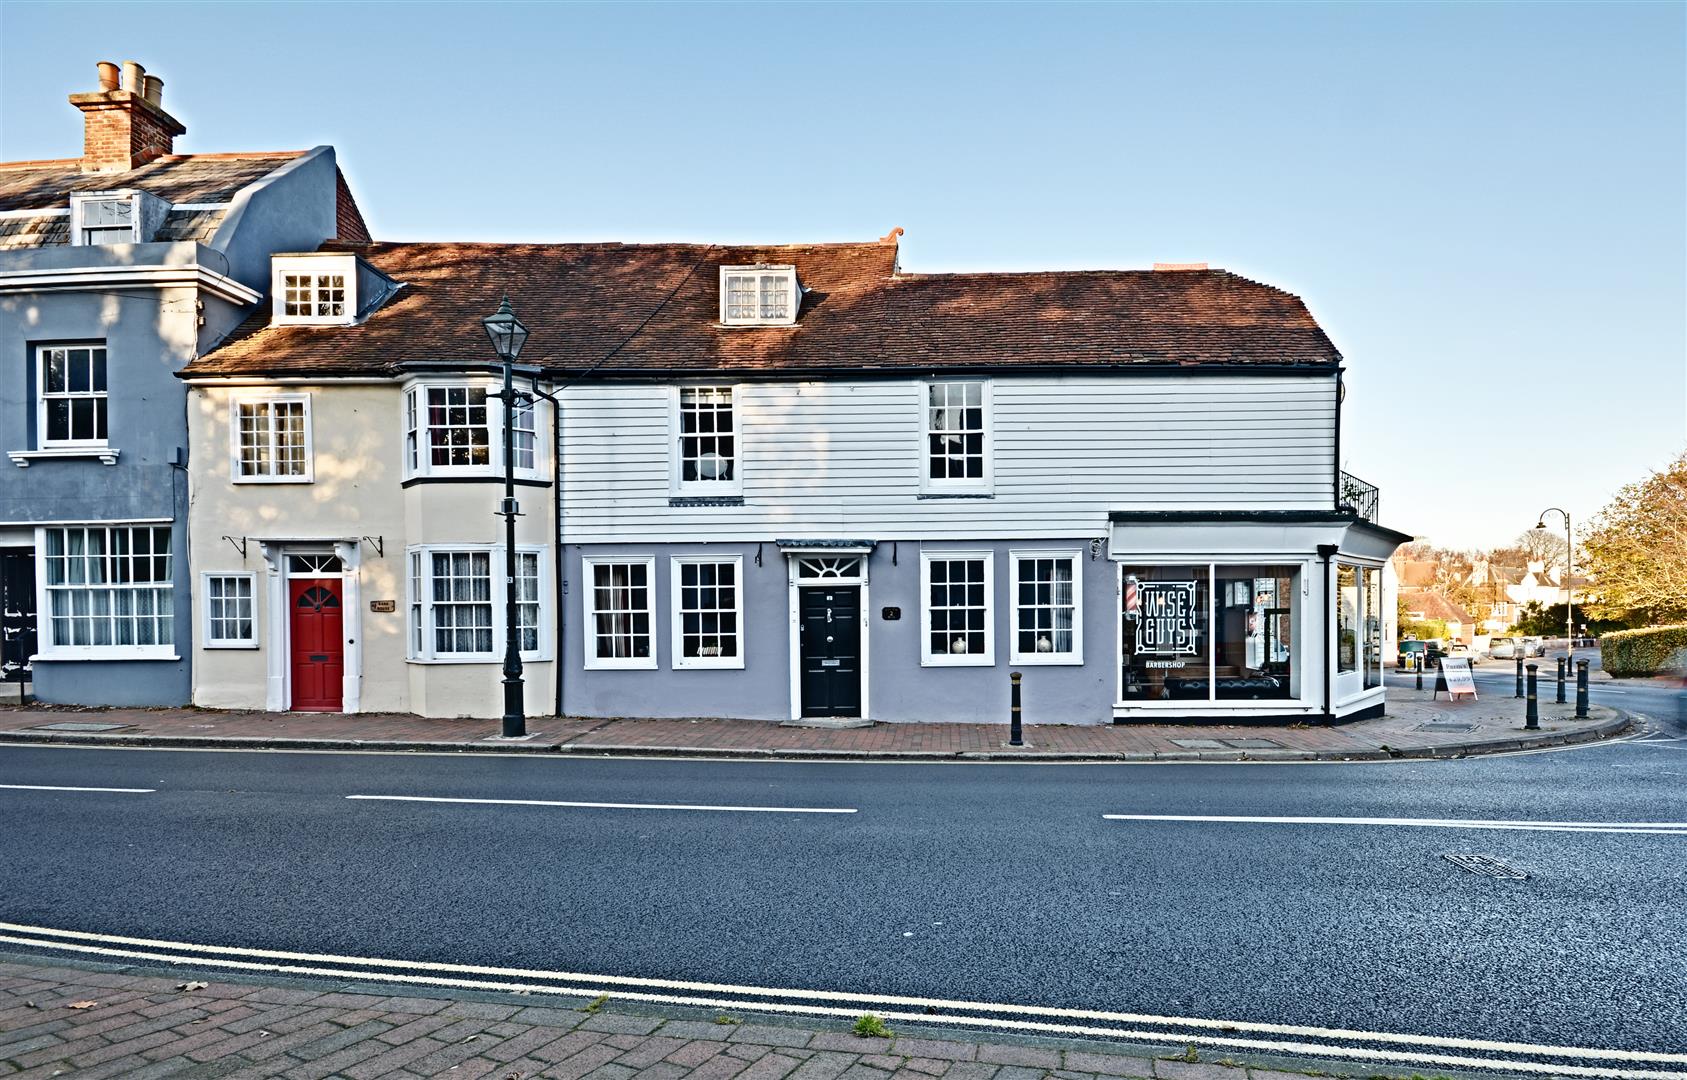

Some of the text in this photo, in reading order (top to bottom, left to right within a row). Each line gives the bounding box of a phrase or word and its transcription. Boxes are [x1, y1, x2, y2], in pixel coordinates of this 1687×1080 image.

[1145, 591, 1187, 617] WISE
[1145, 618, 1187, 645] GUYS
[1145, 661, 1186, 669] BARBERSHOP
